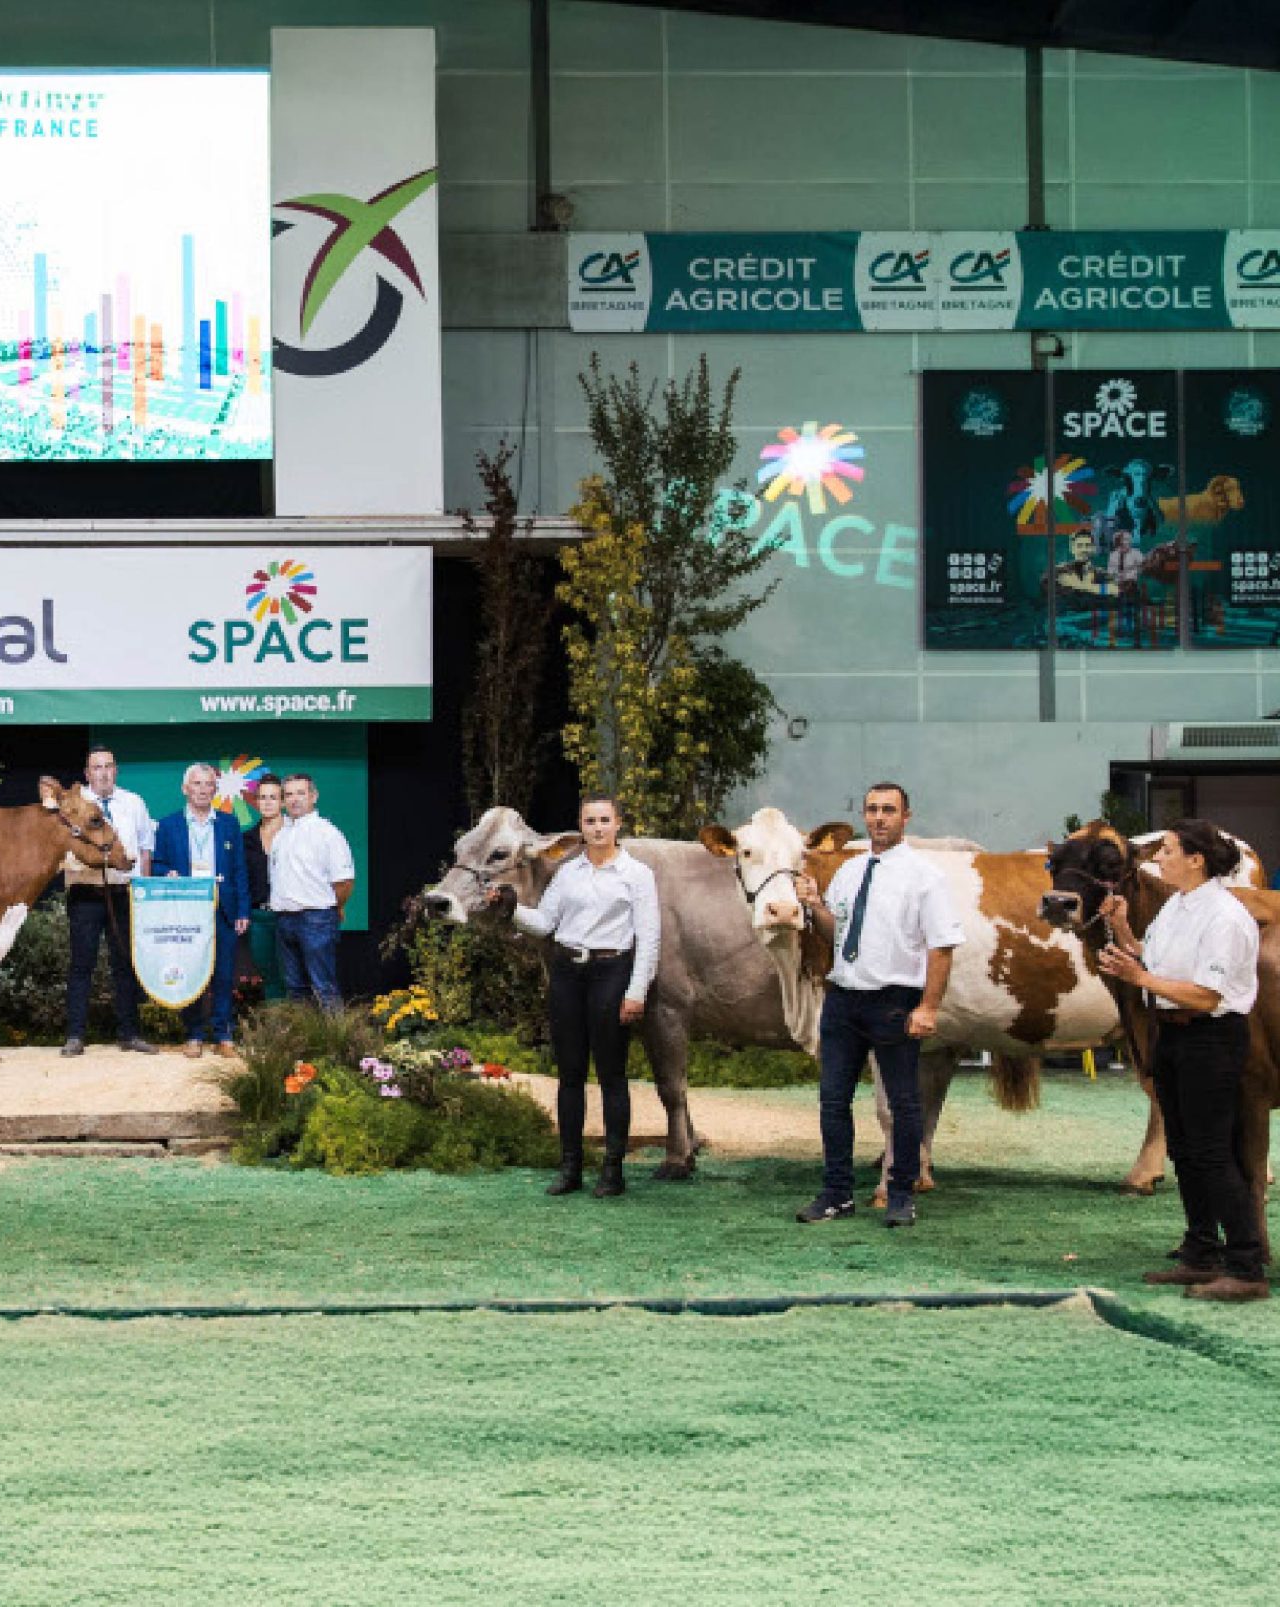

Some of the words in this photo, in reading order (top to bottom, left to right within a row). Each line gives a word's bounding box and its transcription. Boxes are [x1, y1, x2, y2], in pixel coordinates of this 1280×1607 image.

[688, 253, 816, 281] CRÉDIT
[1058, 250, 1186, 279] CRÉDIT
[665, 287, 844, 312] AGRICOLE
[1034, 286, 1213, 311] AGRICOLE
[1063, 412, 1168, 438] SPACE
[187, 618, 370, 664] SPACE
[200, 690, 357, 715] www.space.fr
